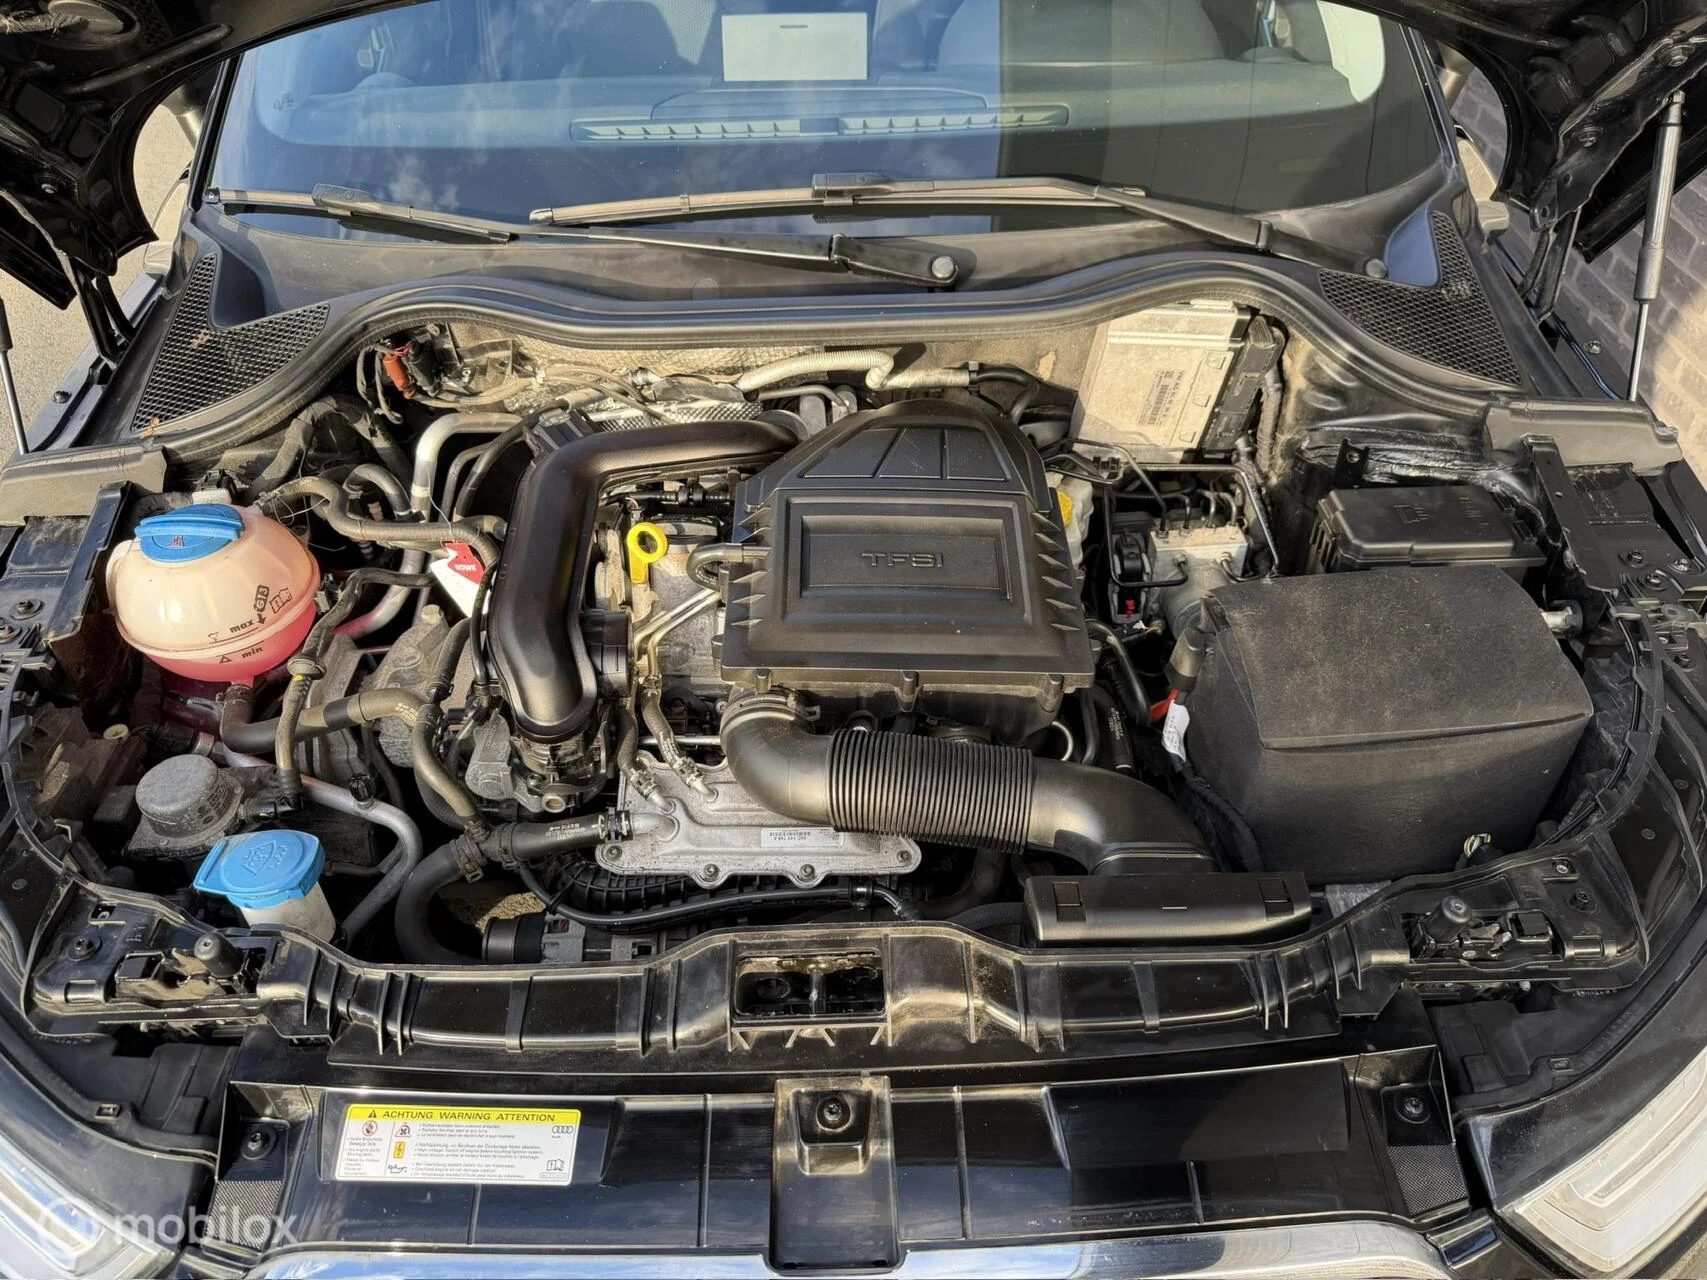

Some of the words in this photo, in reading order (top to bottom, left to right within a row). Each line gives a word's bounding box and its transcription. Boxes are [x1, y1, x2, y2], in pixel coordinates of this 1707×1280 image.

[861, 552, 944, 567] TFSI
[255, 586, 268, 610] G13
[229, 619, 255, 633] max
[241, 647, 263, 659] min
[382, 1110, 434, 1119] ACHTUNG
[439, 1111, 491, 1120] WARNING
[496, 1113, 556, 1121] ATTENTION
